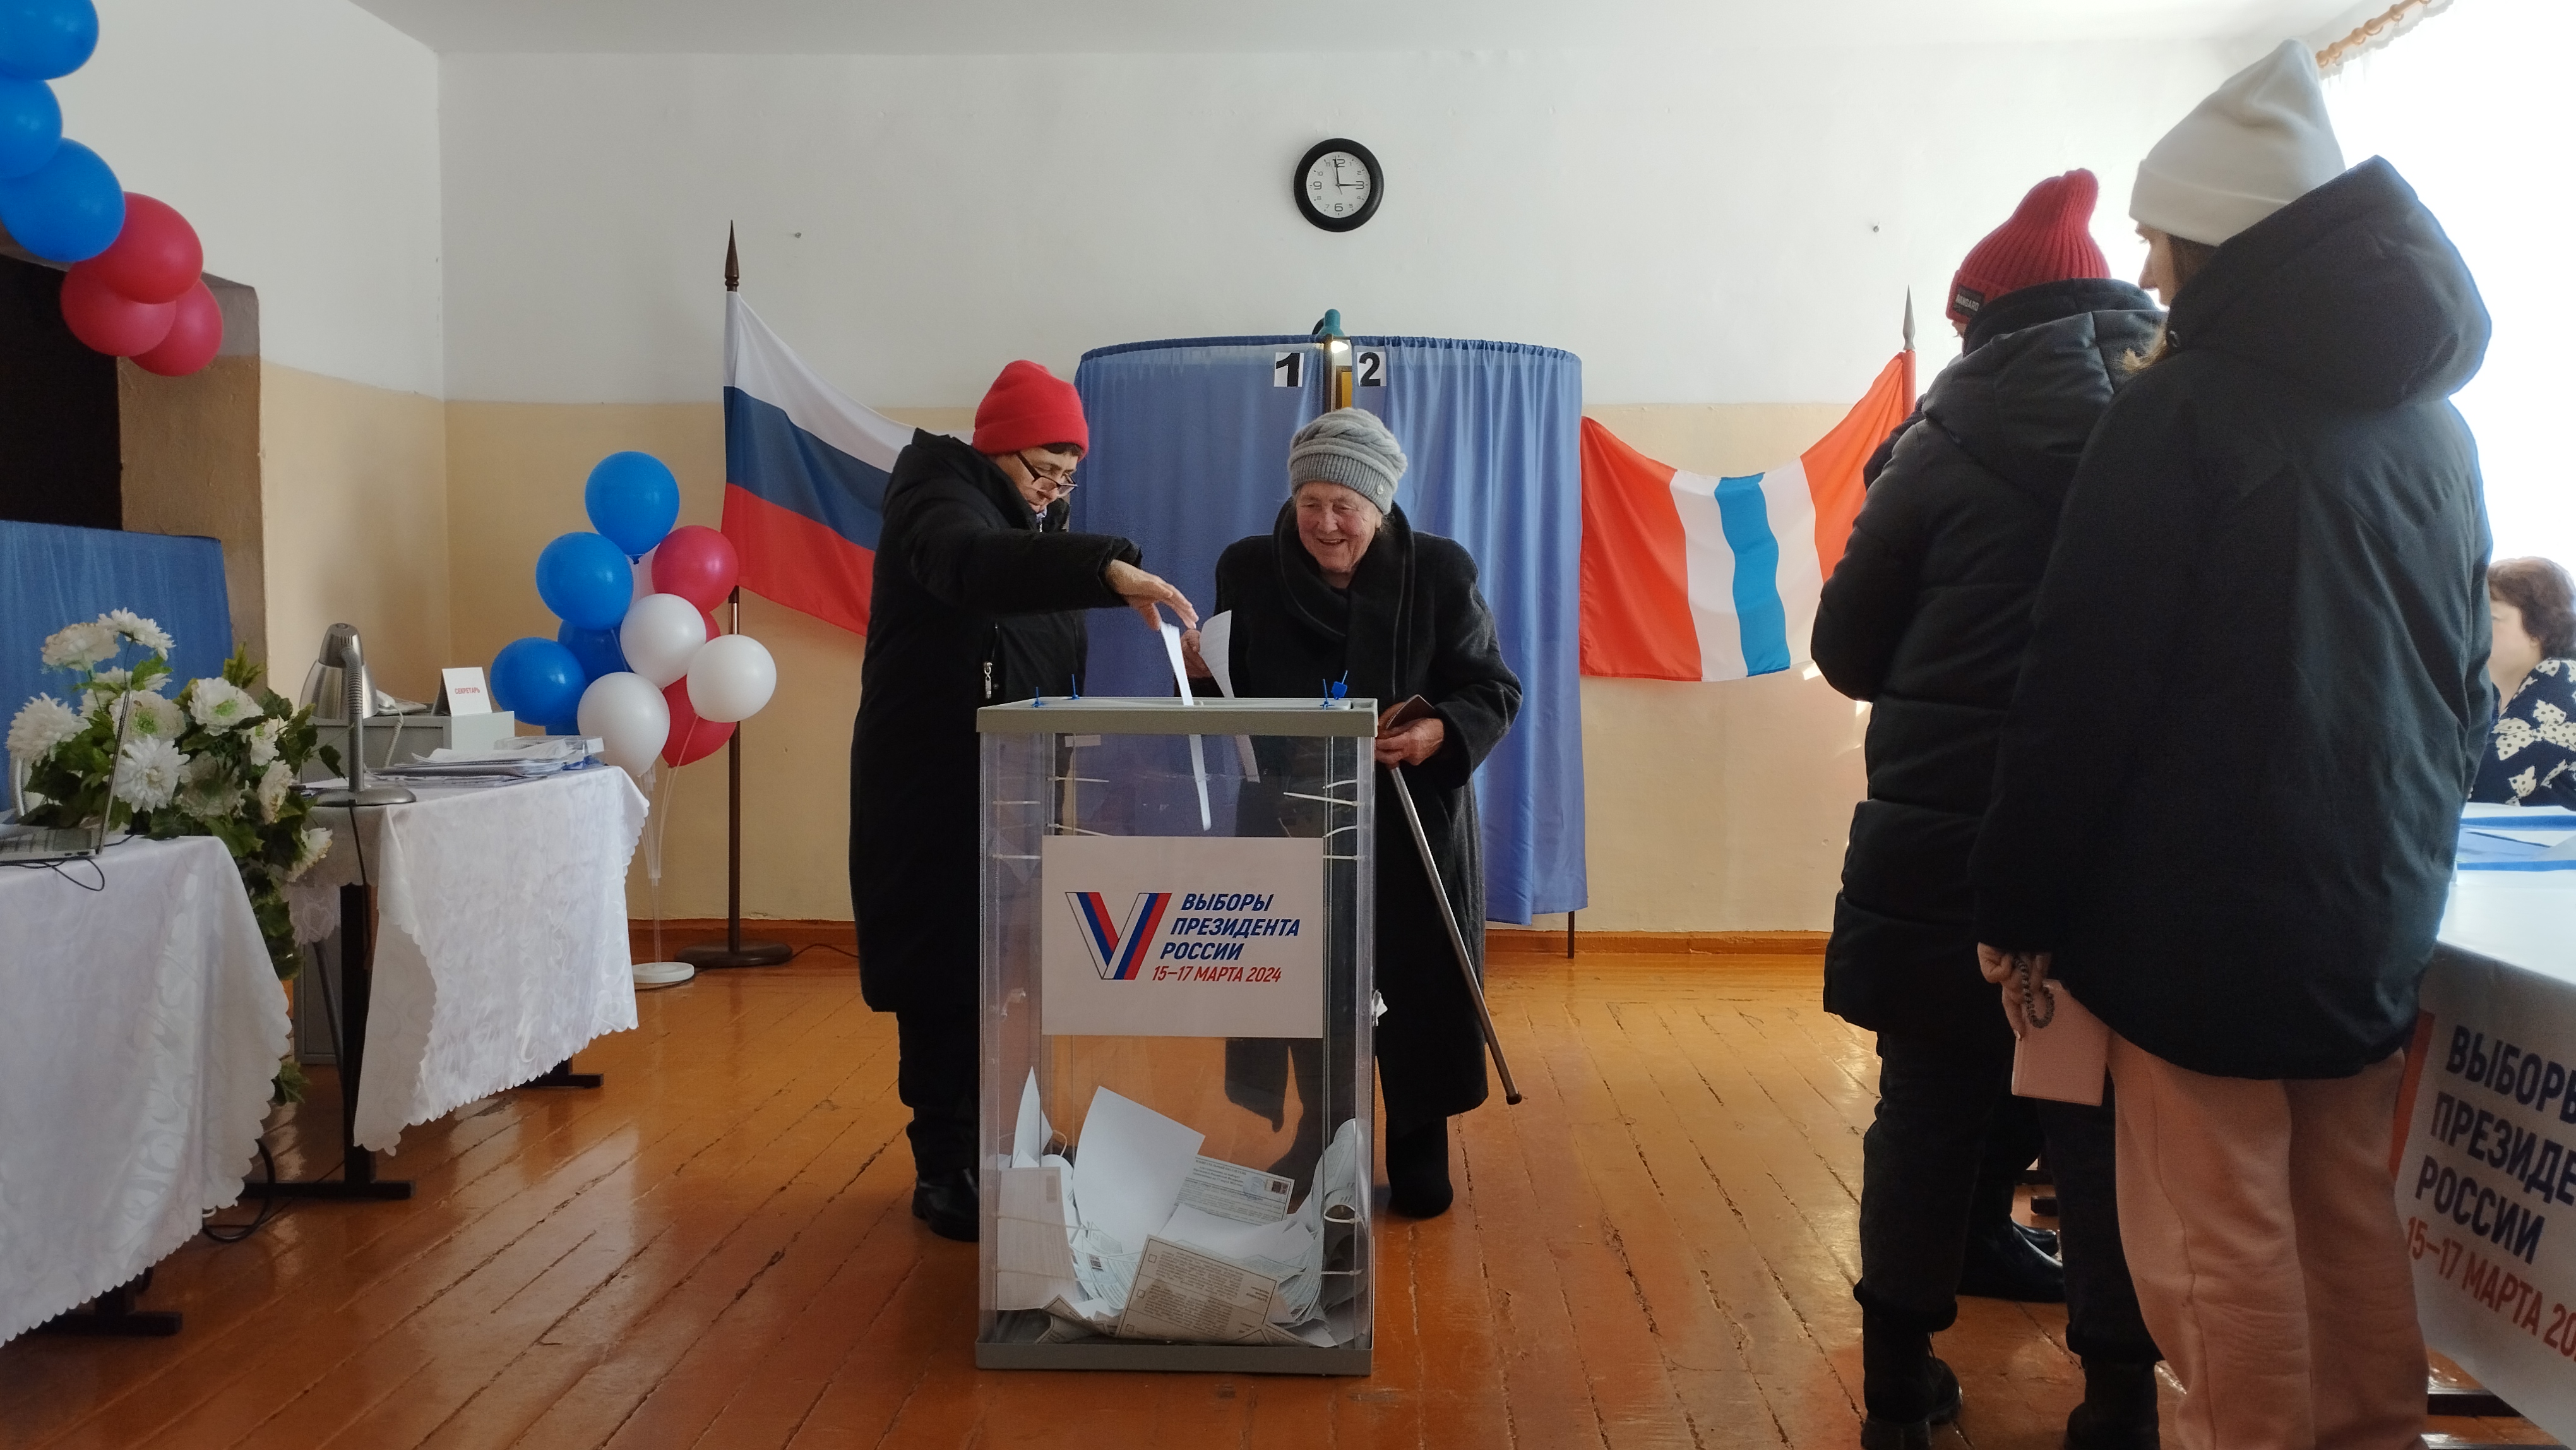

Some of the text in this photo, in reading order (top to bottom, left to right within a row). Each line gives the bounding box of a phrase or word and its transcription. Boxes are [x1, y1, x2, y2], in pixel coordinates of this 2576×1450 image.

[1332, 159, 1345, 168] 12
[1313, 181, 1322, 190] 9
[1356, 181, 1365, 190] 3
[1334, 203, 1344, 212] 6
[1275, 352, 1301, 387] 1
[1359, 352, 1381, 386] 2
[1180, 893, 1275, 911] ВЫБОРЫ
[1170, 918, 1301, 939] ПРЕЗИДЕНТА
[1160, 942, 1245, 961] РОССИИ
[1193, 966, 1244, 982] МАРТА
[1245, 967, 1282, 983] 2024
[2431, 1091, 2576, 1206] ПРЕЗИДЕ
[2415, 1154, 2546, 1265] РОССИИ
[2462, 1250, 2543, 1336] МАРТА
[2543, 1302, 2576, 1362] 20
